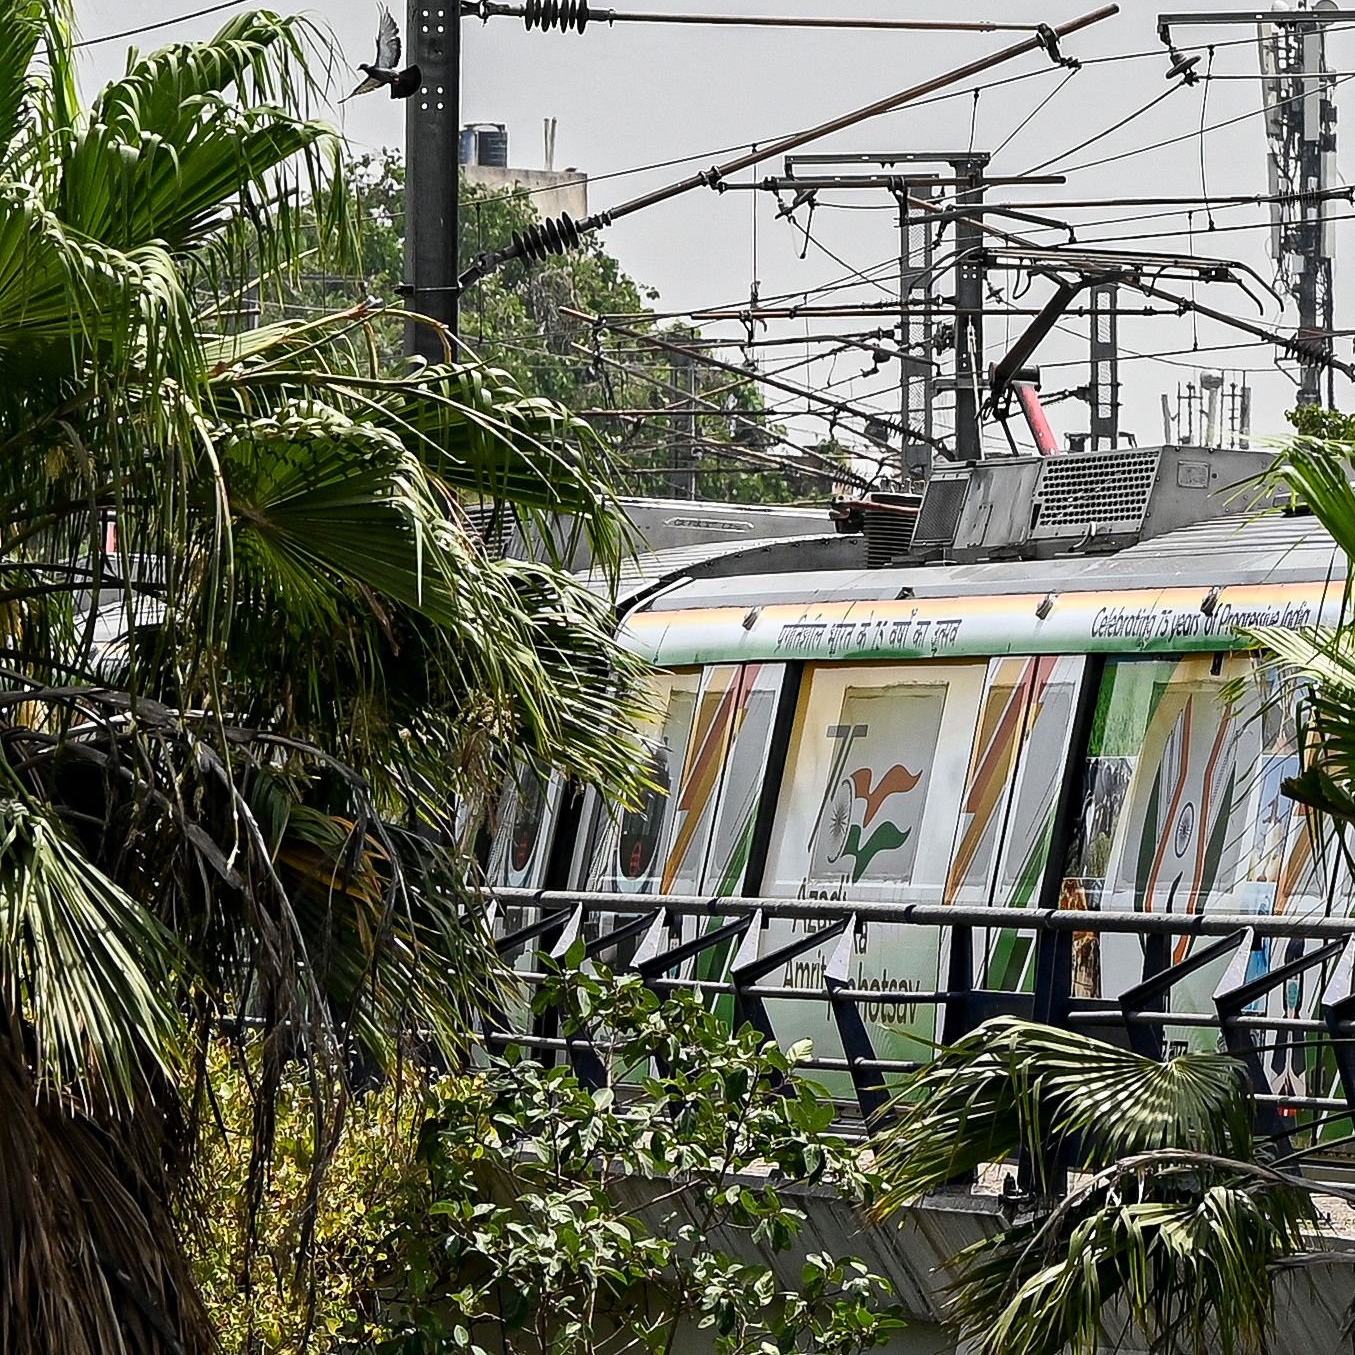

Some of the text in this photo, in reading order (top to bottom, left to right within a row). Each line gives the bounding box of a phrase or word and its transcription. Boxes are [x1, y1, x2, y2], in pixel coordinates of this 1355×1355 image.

[1091, 606, 1156, 650] Celebrating
[1168, 612, 1201, 643] years
[1203, 603, 1223, 636] of
